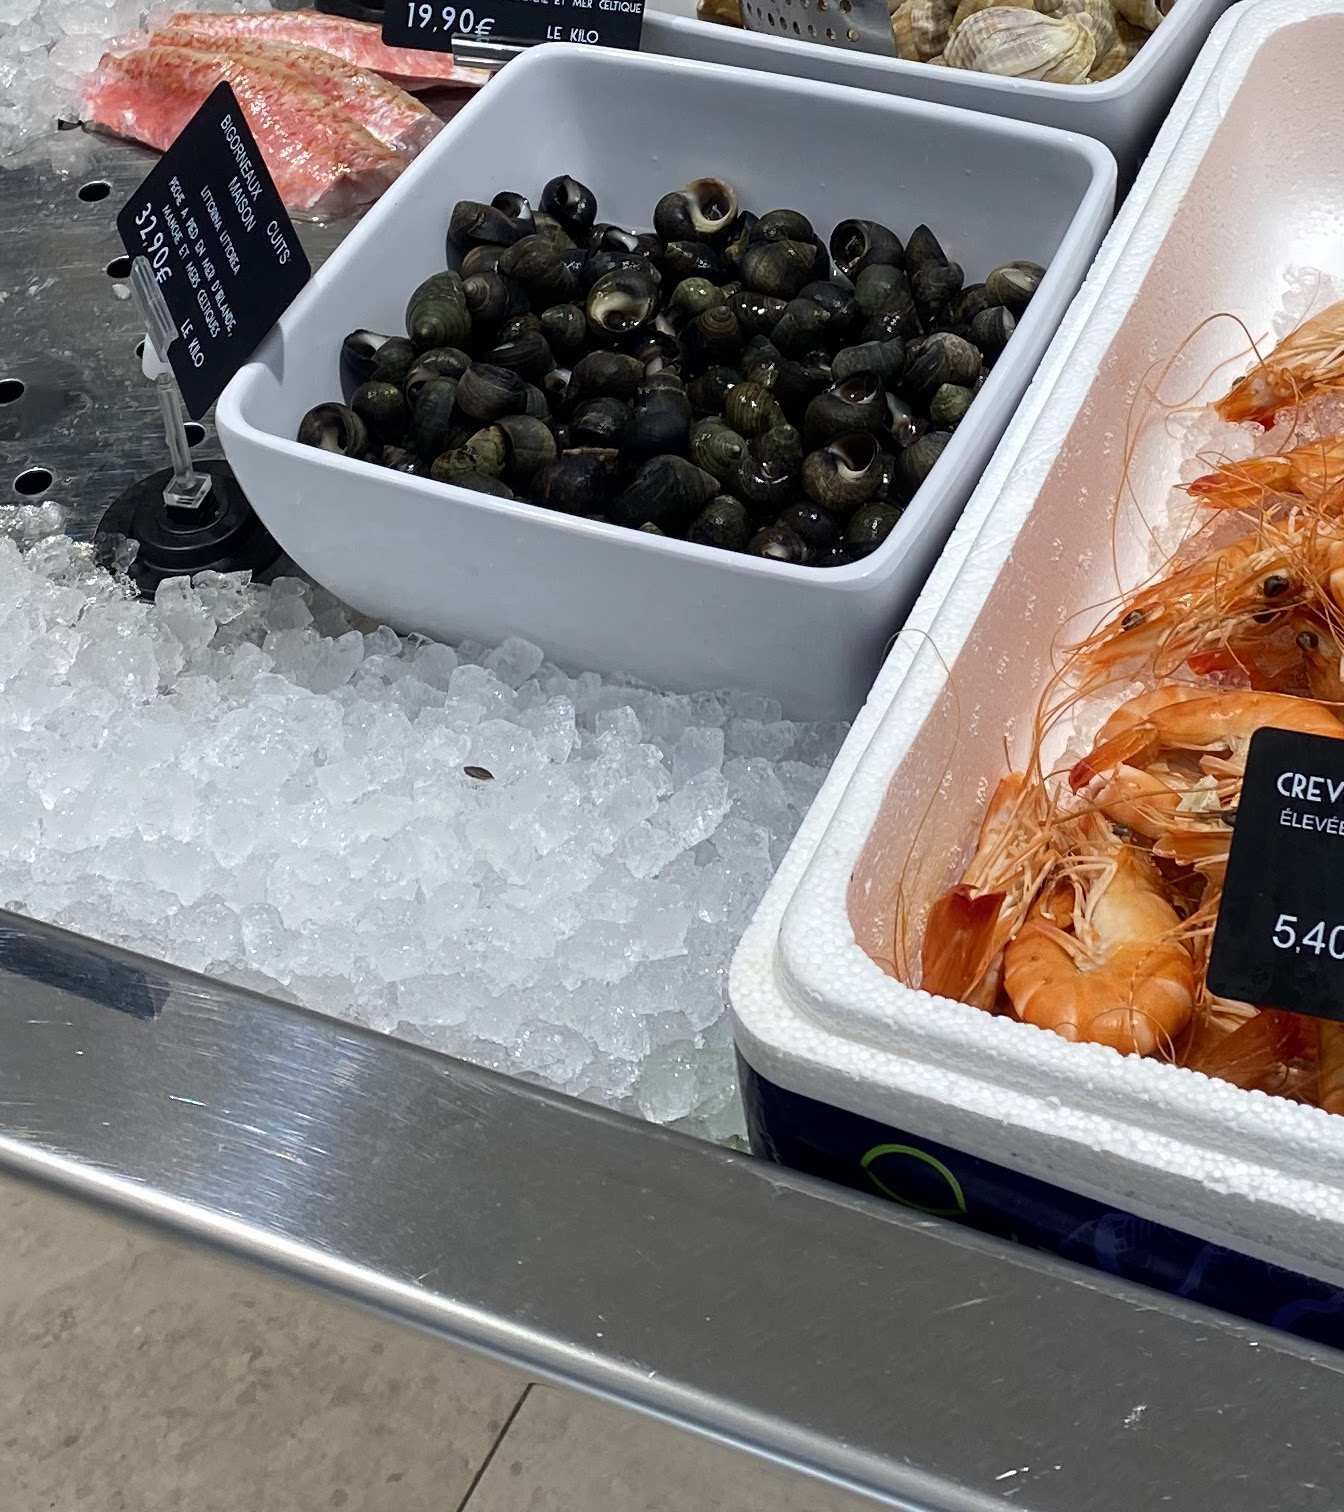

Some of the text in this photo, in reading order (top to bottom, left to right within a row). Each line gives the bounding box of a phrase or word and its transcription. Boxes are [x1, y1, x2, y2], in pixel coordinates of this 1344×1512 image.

[547, 25, 562, 39] LE
[570, 28, 599, 44] KILO
[220, 114, 263, 202] BIGORNEAUX
[228, 176, 256, 233] MAISON
[180, 318, 193, 340] LE
[188, 335, 205, 368] KILO
